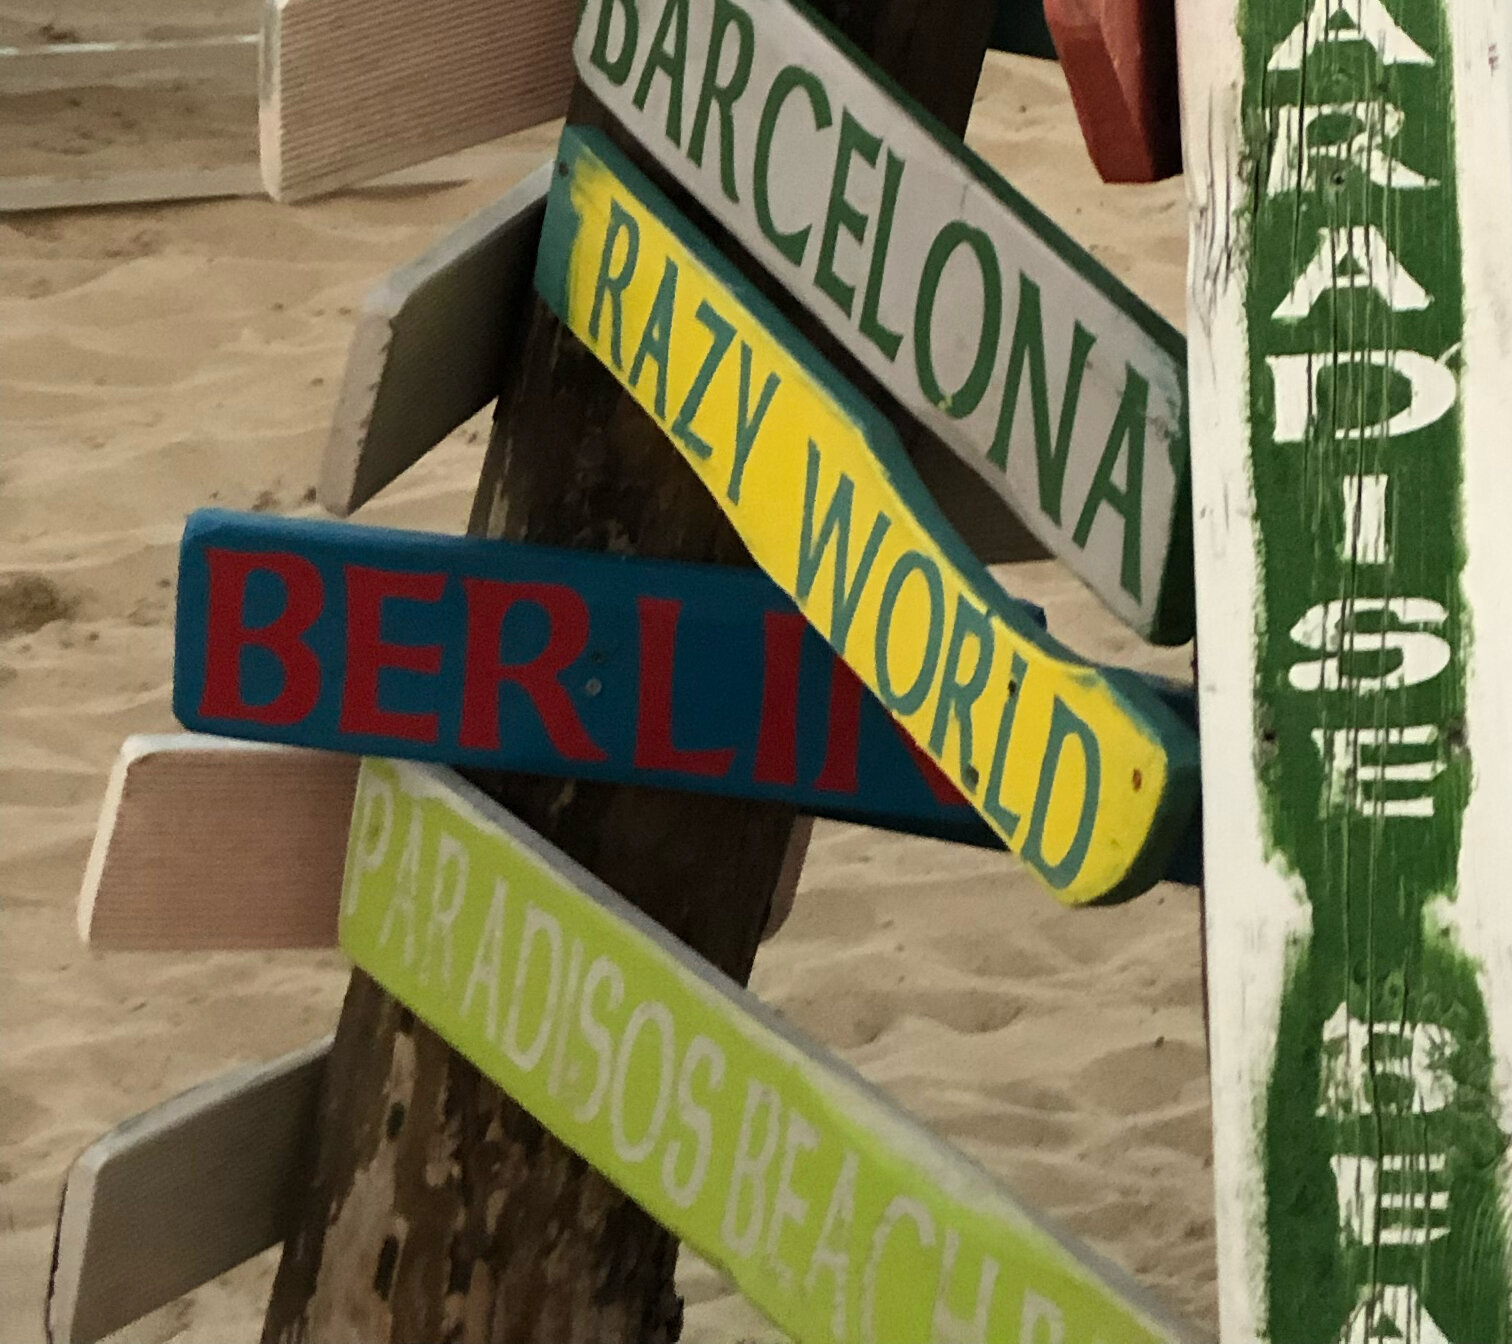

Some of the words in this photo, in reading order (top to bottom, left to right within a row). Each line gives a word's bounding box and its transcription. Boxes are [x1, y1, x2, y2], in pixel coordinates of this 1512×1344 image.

[588, 194, 783, 507] RAZY
[796, 436, 1101, 890] WORLD
[346, 771, 728, 1211] PARADISOS
